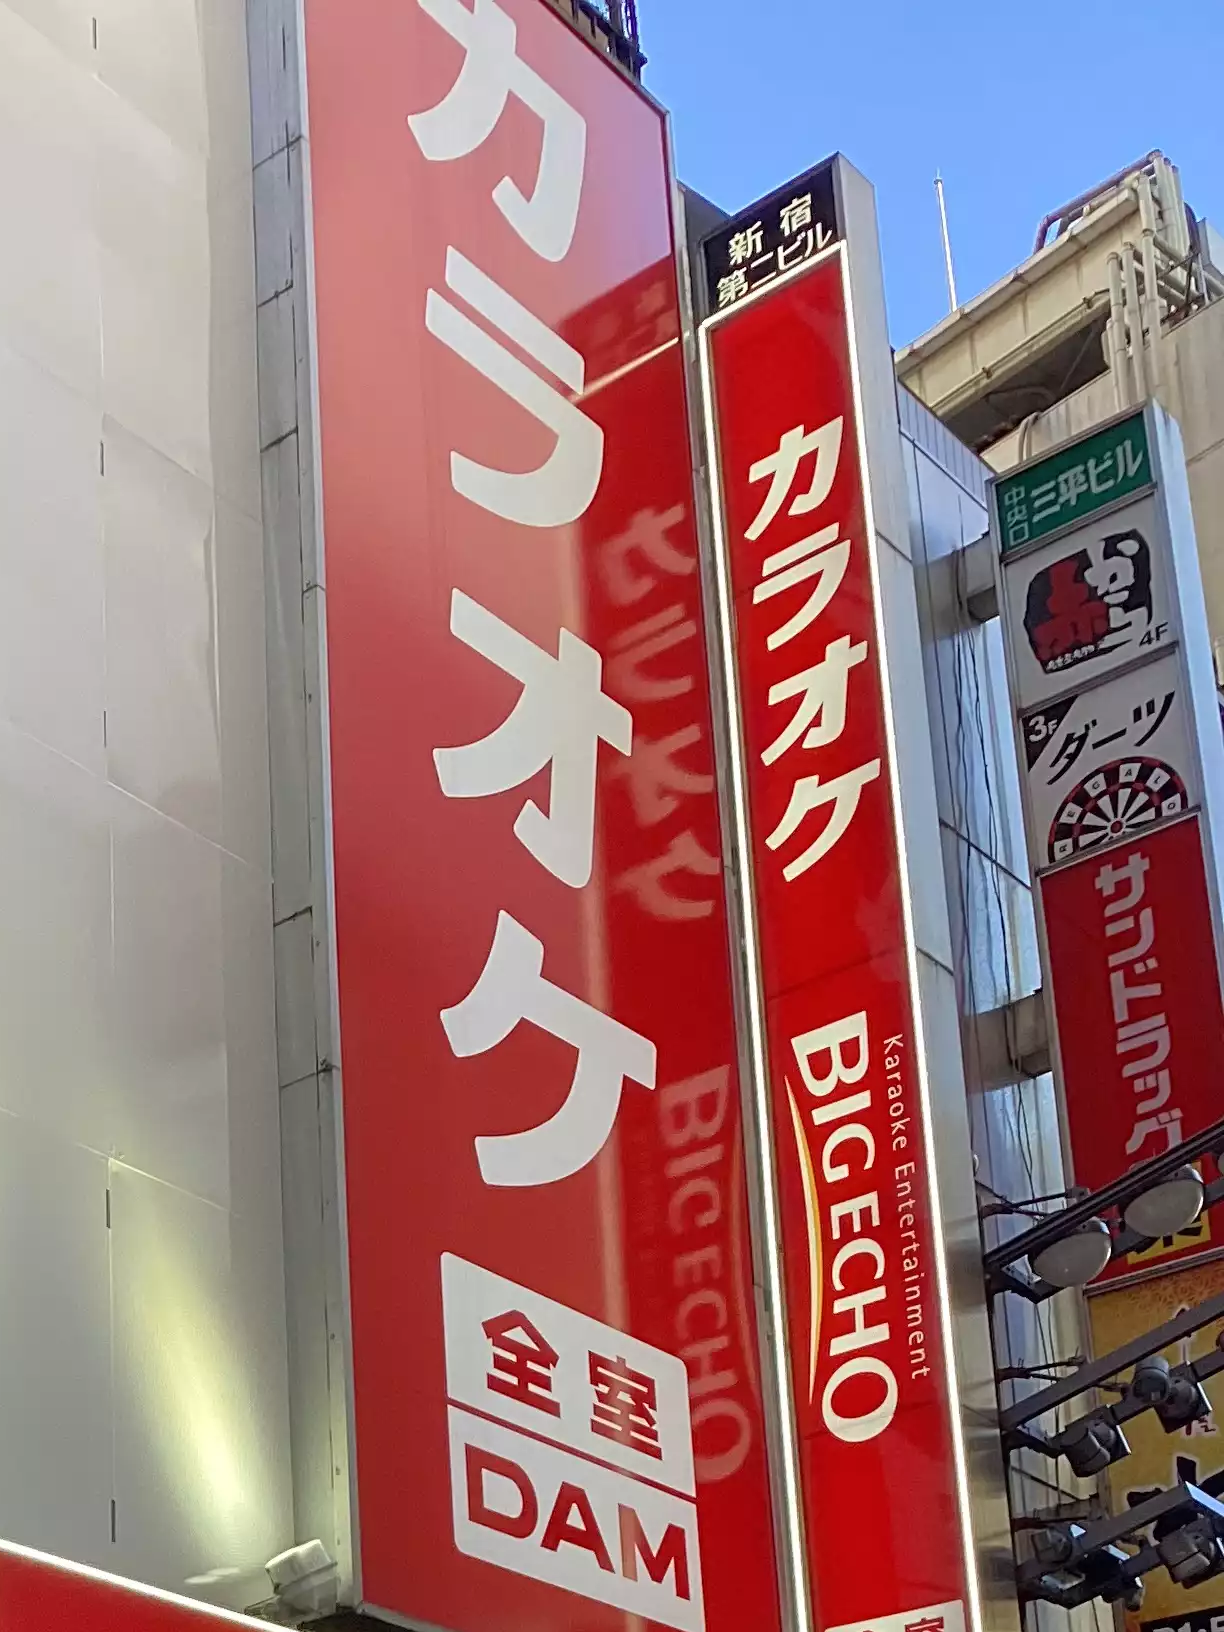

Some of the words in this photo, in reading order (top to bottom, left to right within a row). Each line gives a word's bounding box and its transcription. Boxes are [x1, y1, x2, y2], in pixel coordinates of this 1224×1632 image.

[718, 221, 833, 307] 第二ビル
[728, 191, 813, 266] 新宿
[1004, 485, 1029, 547] 中央口
[1030, 439, 1144, 523] 三平ビル
[408, 0, 657, 1187] カラオケ
[744, 415, 882, 882] カラオケ
[1139, 622, 1169, 648] 4F
[1028, 714, 1058, 744] 3F
[1047, 691, 1176, 786] ダーツ
[1095, 851, 1184, 1155] サンドラッグ
[790, 1010, 876, 1184] BIG
[883, 1033, 910, 1151] Karaoke
[821, 1190, 899, 1443] ECHO
[894, 1161, 931, 1381] Entertainment
[480, 1307, 661, 1461] 全室
[467, 1441, 690, 1602] DAM
